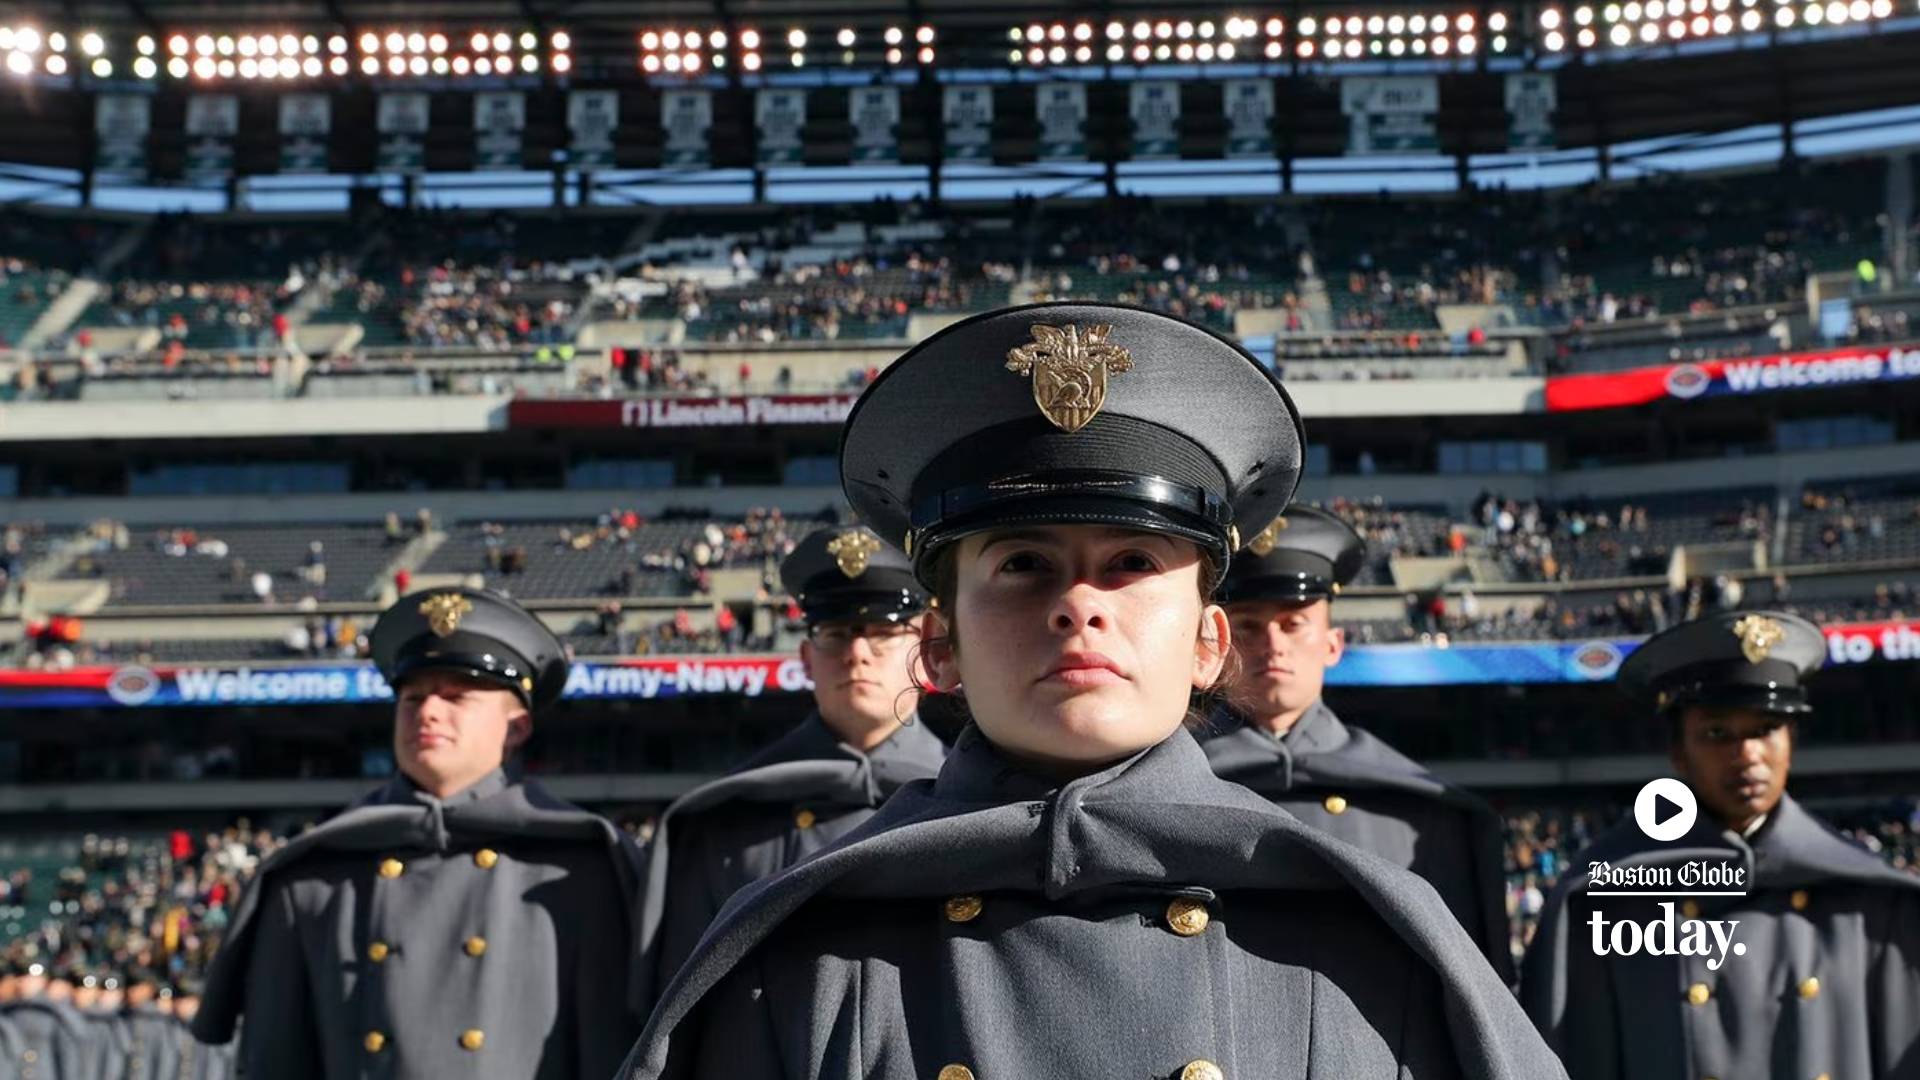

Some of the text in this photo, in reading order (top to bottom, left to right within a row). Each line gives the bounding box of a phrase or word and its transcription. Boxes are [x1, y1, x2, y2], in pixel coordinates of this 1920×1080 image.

[1724, 349, 1920, 391] Welcome to
[653, 399, 744, 425] Lincoln
[1829, 631, 1874, 663] to
[175, 666, 347, 701] Welcome
[563, 662, 768, 697] Army-Navy
